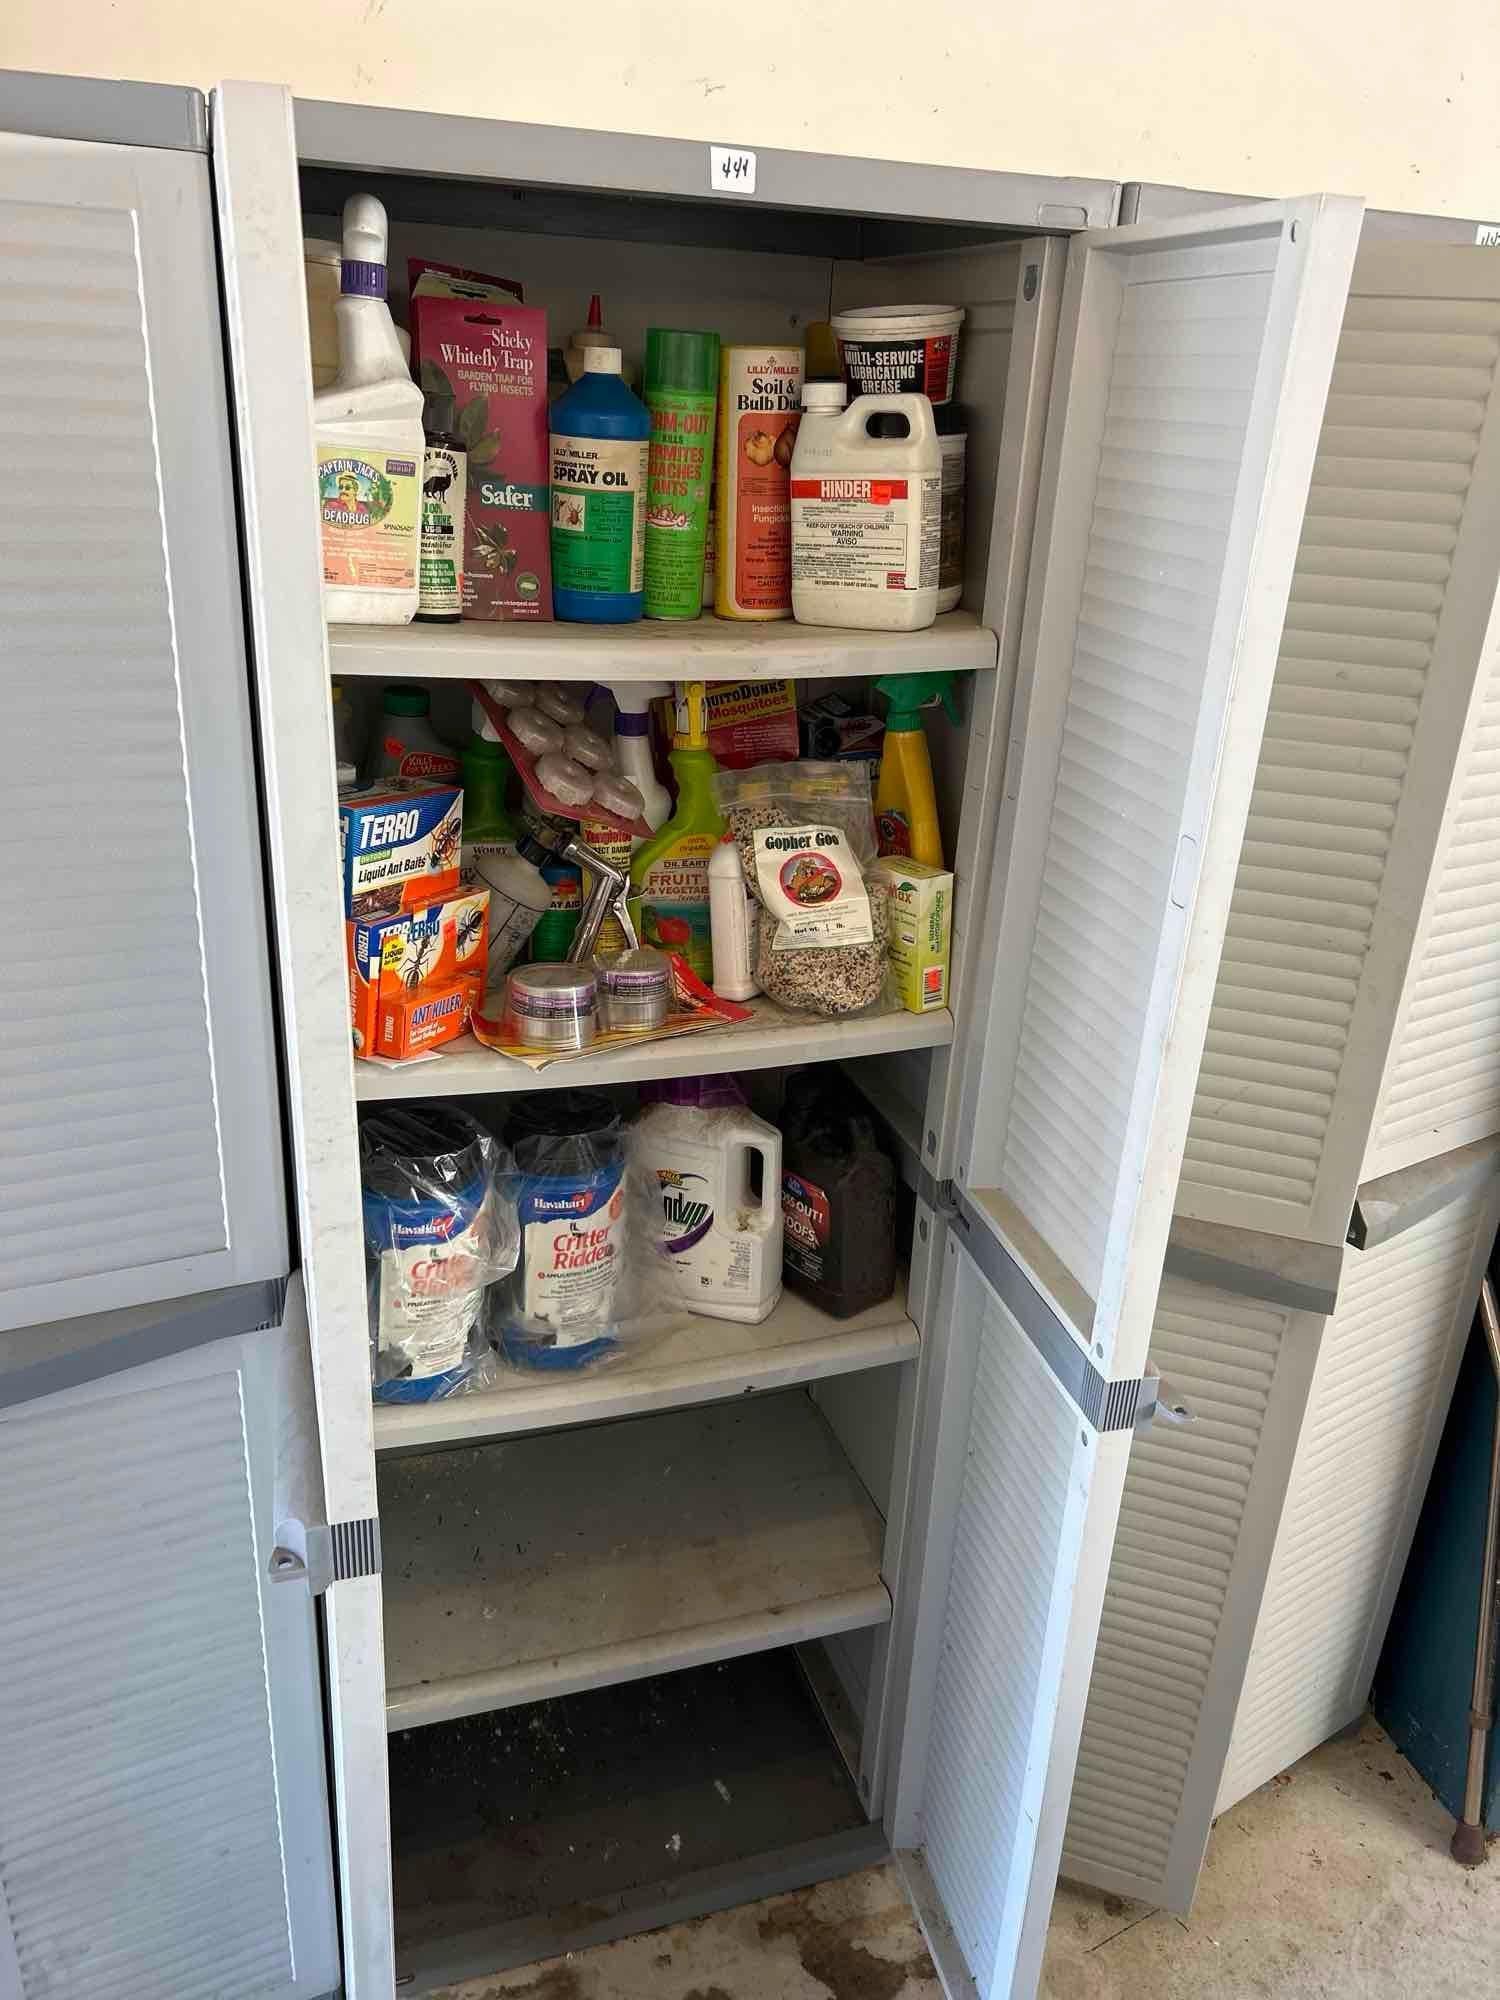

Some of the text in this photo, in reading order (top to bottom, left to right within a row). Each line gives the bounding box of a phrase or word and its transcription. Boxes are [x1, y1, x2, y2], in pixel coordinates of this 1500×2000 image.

[491, 327, 533, 355] Sticky
[440, 343, 533, 376] Whitefly Trap
[844, 349, 924, 366] MULTI-SERVICE
[458, 369, 493, 381] GARDEN
[518, 376, 534, 386] FOR
[747, 365, 769, 375] LILLY
[850, 365, 916, 380] LUBRICATING
[469, 381, 535, 397] FLYING INSECTS
[752, 378, 795, 395] Soil &
[861, 380, 902, 394] GREASE
[737, 394, 774, 411] Bulb
[569, 450, 599, 460] MILLER
[553, 466, 629, 487] SPRAY OIL
[481, 483, 534, 508] Safer
[820, 480, 872, 499] HINDER
[324, 508, 371, 526] DEADBUG
[831, 529, 864, 539] WARNING
[836, 537, 858, 547] AVISO
[360, 808, 420, 850] TERRO
[765, 832, 840, 852] Gopher Goo
[358, 856, 427, 883] Liquid Ant Baits
[682, 860, 711, 869] EART
[648, 873, 704, 887] FRUIT
[357, 929, 370, 963] TERRO
[411, 993, 462, 1027] ANT KILLER
[783, 1214, 816, 1243] OOFS
[553, 1226, 611, 1252] Critter
